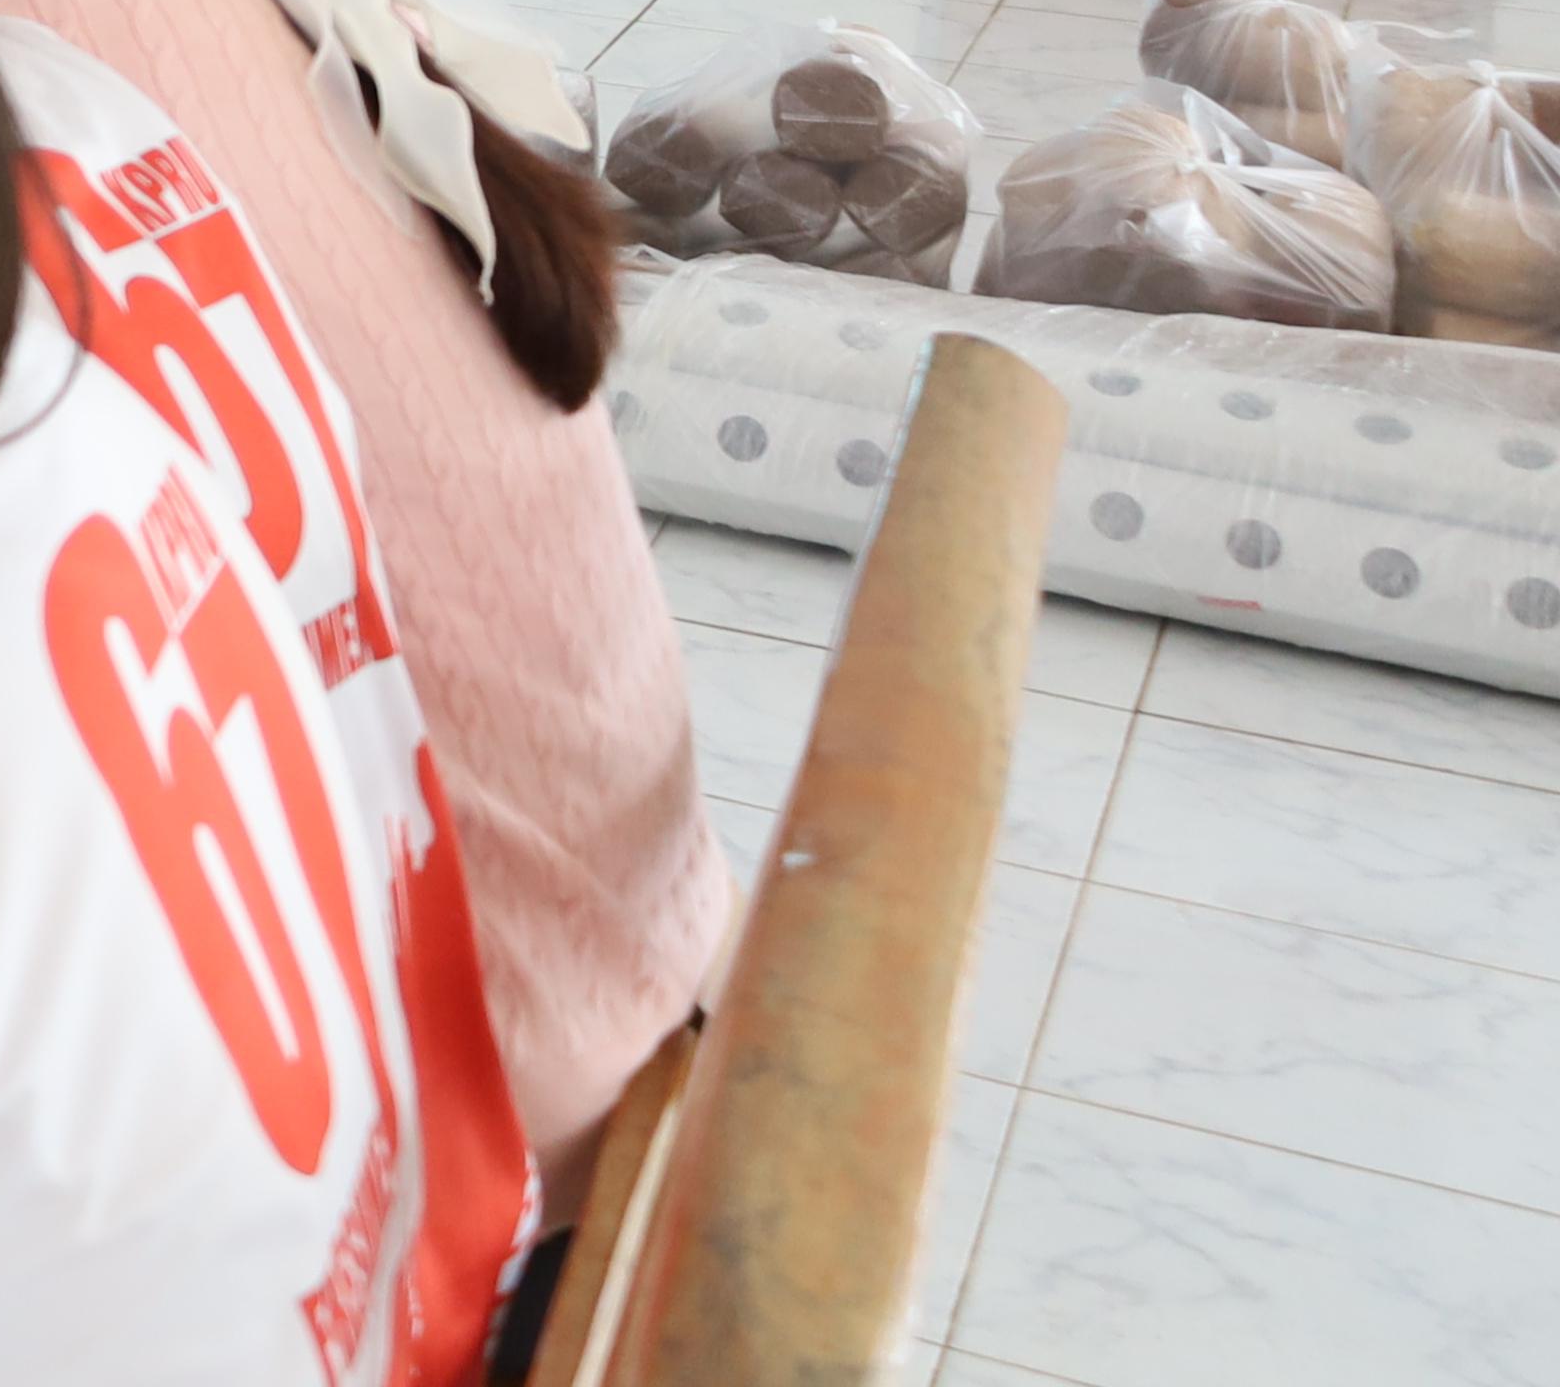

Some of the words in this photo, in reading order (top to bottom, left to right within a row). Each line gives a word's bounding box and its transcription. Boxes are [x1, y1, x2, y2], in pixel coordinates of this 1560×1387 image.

[8, 145, 400, 663] 67
[100, 137, 219, 232] KPRU
[43, 511, 398, 1177] 67
